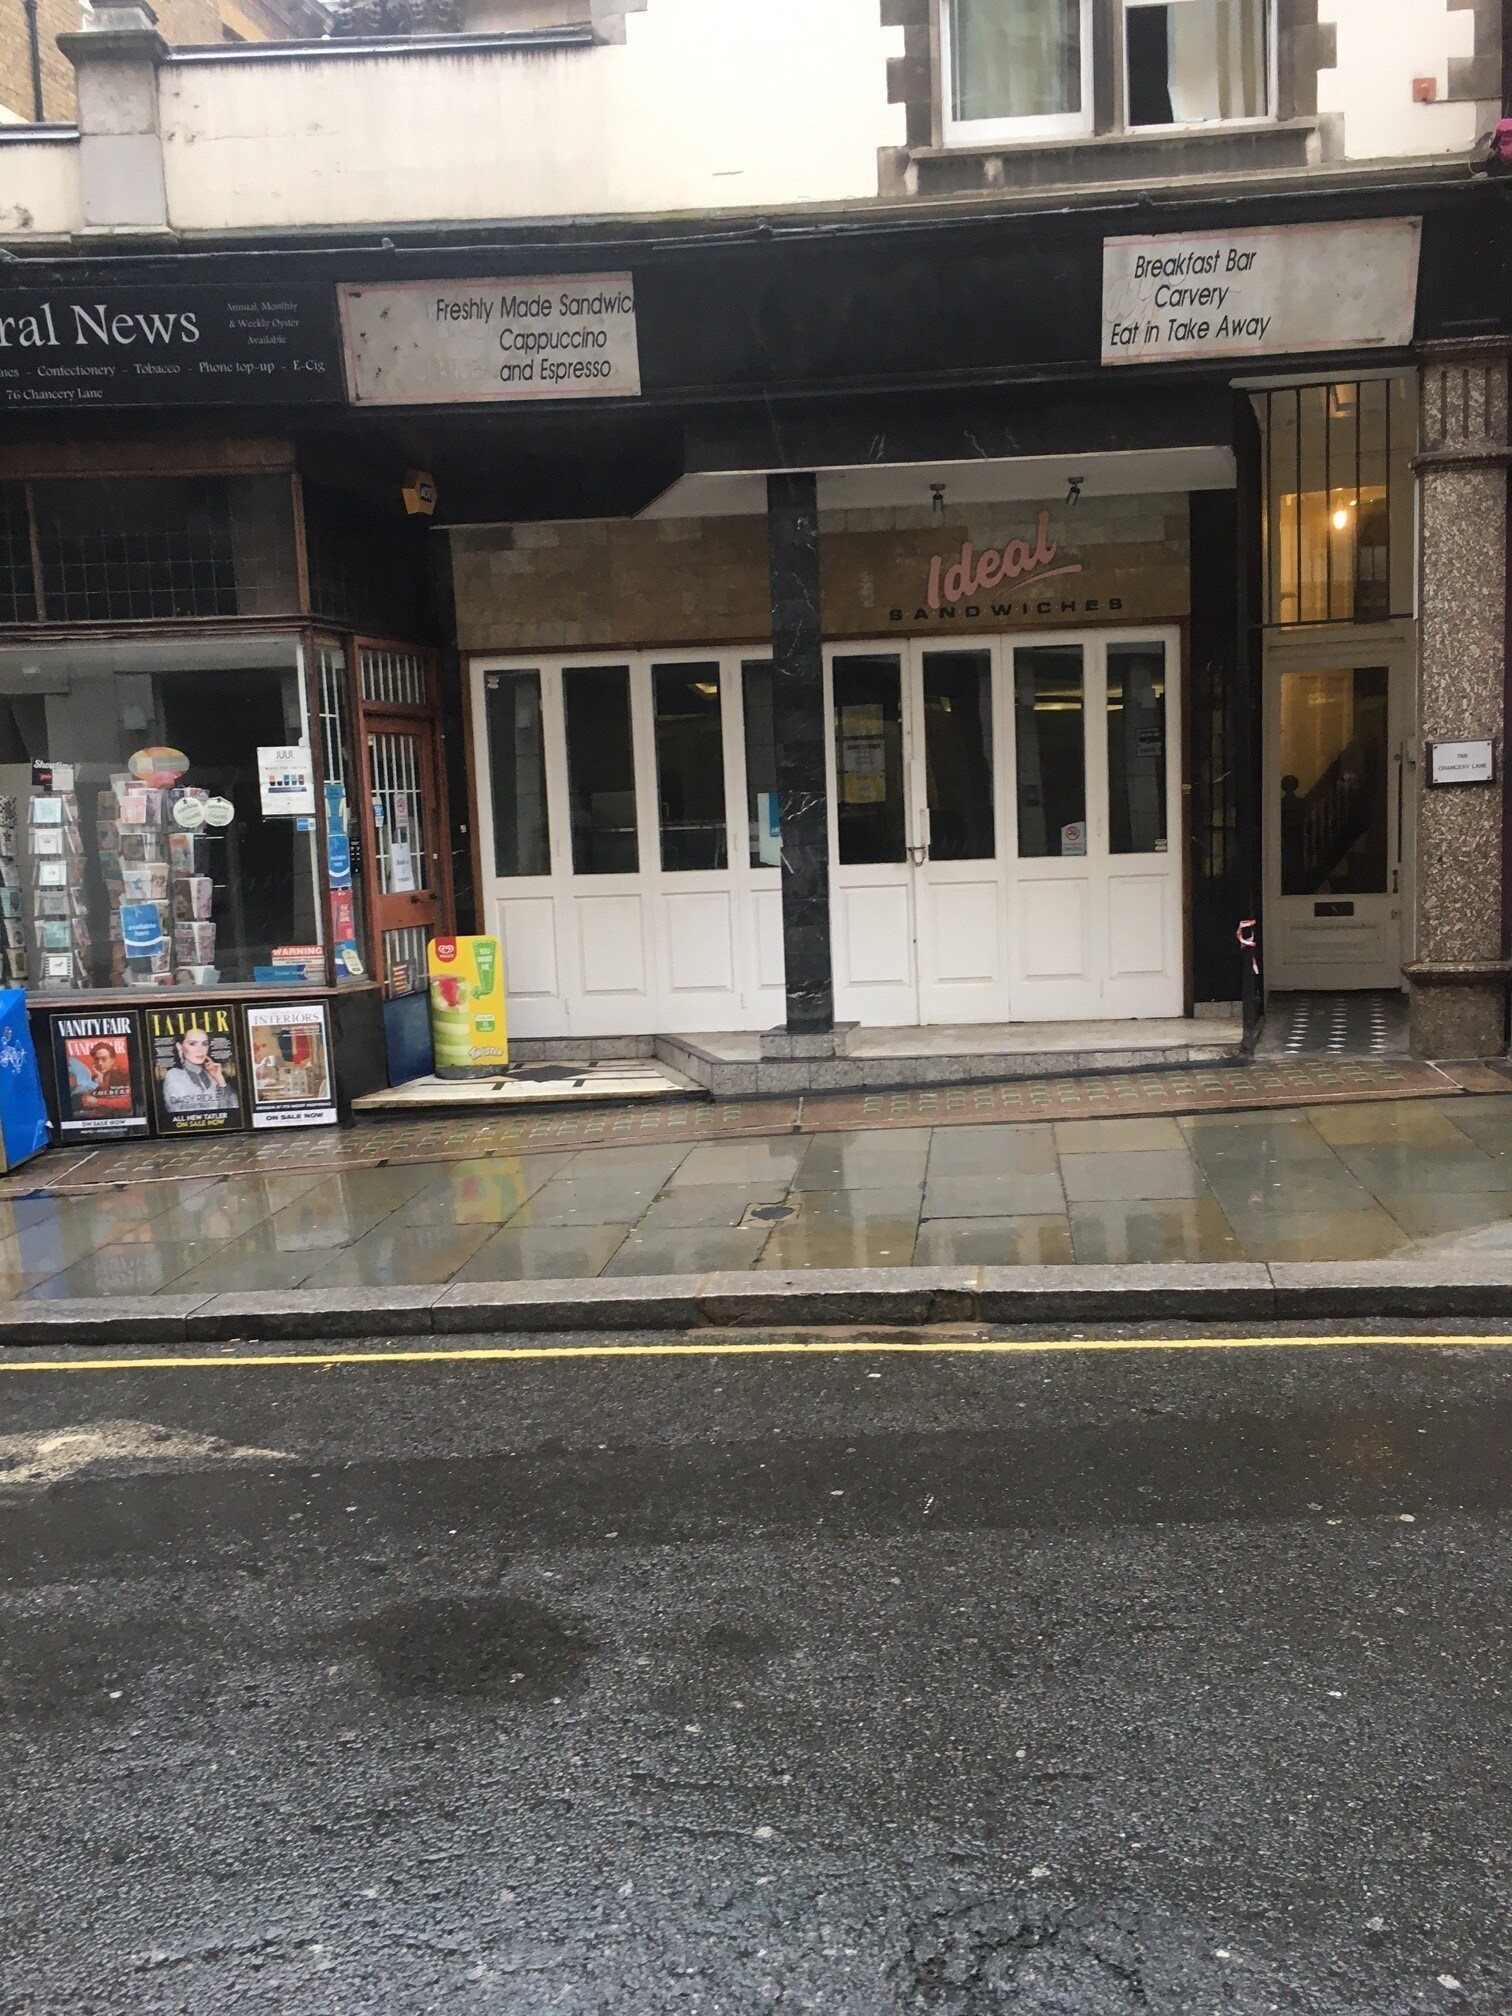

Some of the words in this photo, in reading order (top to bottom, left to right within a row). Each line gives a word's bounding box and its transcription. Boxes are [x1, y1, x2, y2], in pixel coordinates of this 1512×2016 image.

[1134, 249, 1220, 279] Breakfast
[1225, 248, 1257, 272] Bar
[1154, 284, 1230, 310] Carvery
[262, 302, 298, 312] Monthly
[436, 298, 494, 324] Freshly
[500, 295, 552, 318] Made
[559, 291, 635, 316] Sandwic
[0, 302, 61, 347] ral
[70, 303, 200, 347] News
[229, 319, 236, 328] &
[238, 318, 270, 329] Weekly
[272, 318, 299, 329] Oyster
[1110, 322, 1140, 346] Eat
[1143, 320, 1159, 343] in
[1167, 318, 1209, 342] Take
[1215, 315, 1272, 340] Away
[248, 334, 286, 345] Available
[499, 326, 607, 355] Cappuccino
[37, 364, 116, 377] Confectionery
[133, 361, 181, 374] Tobacco
[199, 360, 233, 373] Phone
[235, 361, 275, 375] top-up
[293, 358, 325, 373] E-Cig
[500, 359, 534, 382] and
[540, 358, 611, 384] Espresso
[23, 388, 75, 401] Chancery
[77, 388, 103, 398] Lane
[926, 510, 1057, 610] Ideal
[889, 597, 1123, 621] SANDWICHES
[276, 749, 294, 759] JUUL
[33, 759, 74, 769] Showtime
[272, 947, 323, 956] WARNING
[58, 1019, 101, 1037] VANITY
[102, 1017, 132, 1035] FAIR
[254, 1012, 320, 1025] INTERIORS
[204, 1112, 228, 1120] TATLER
[208, 1118, 225, 1126] NOW
